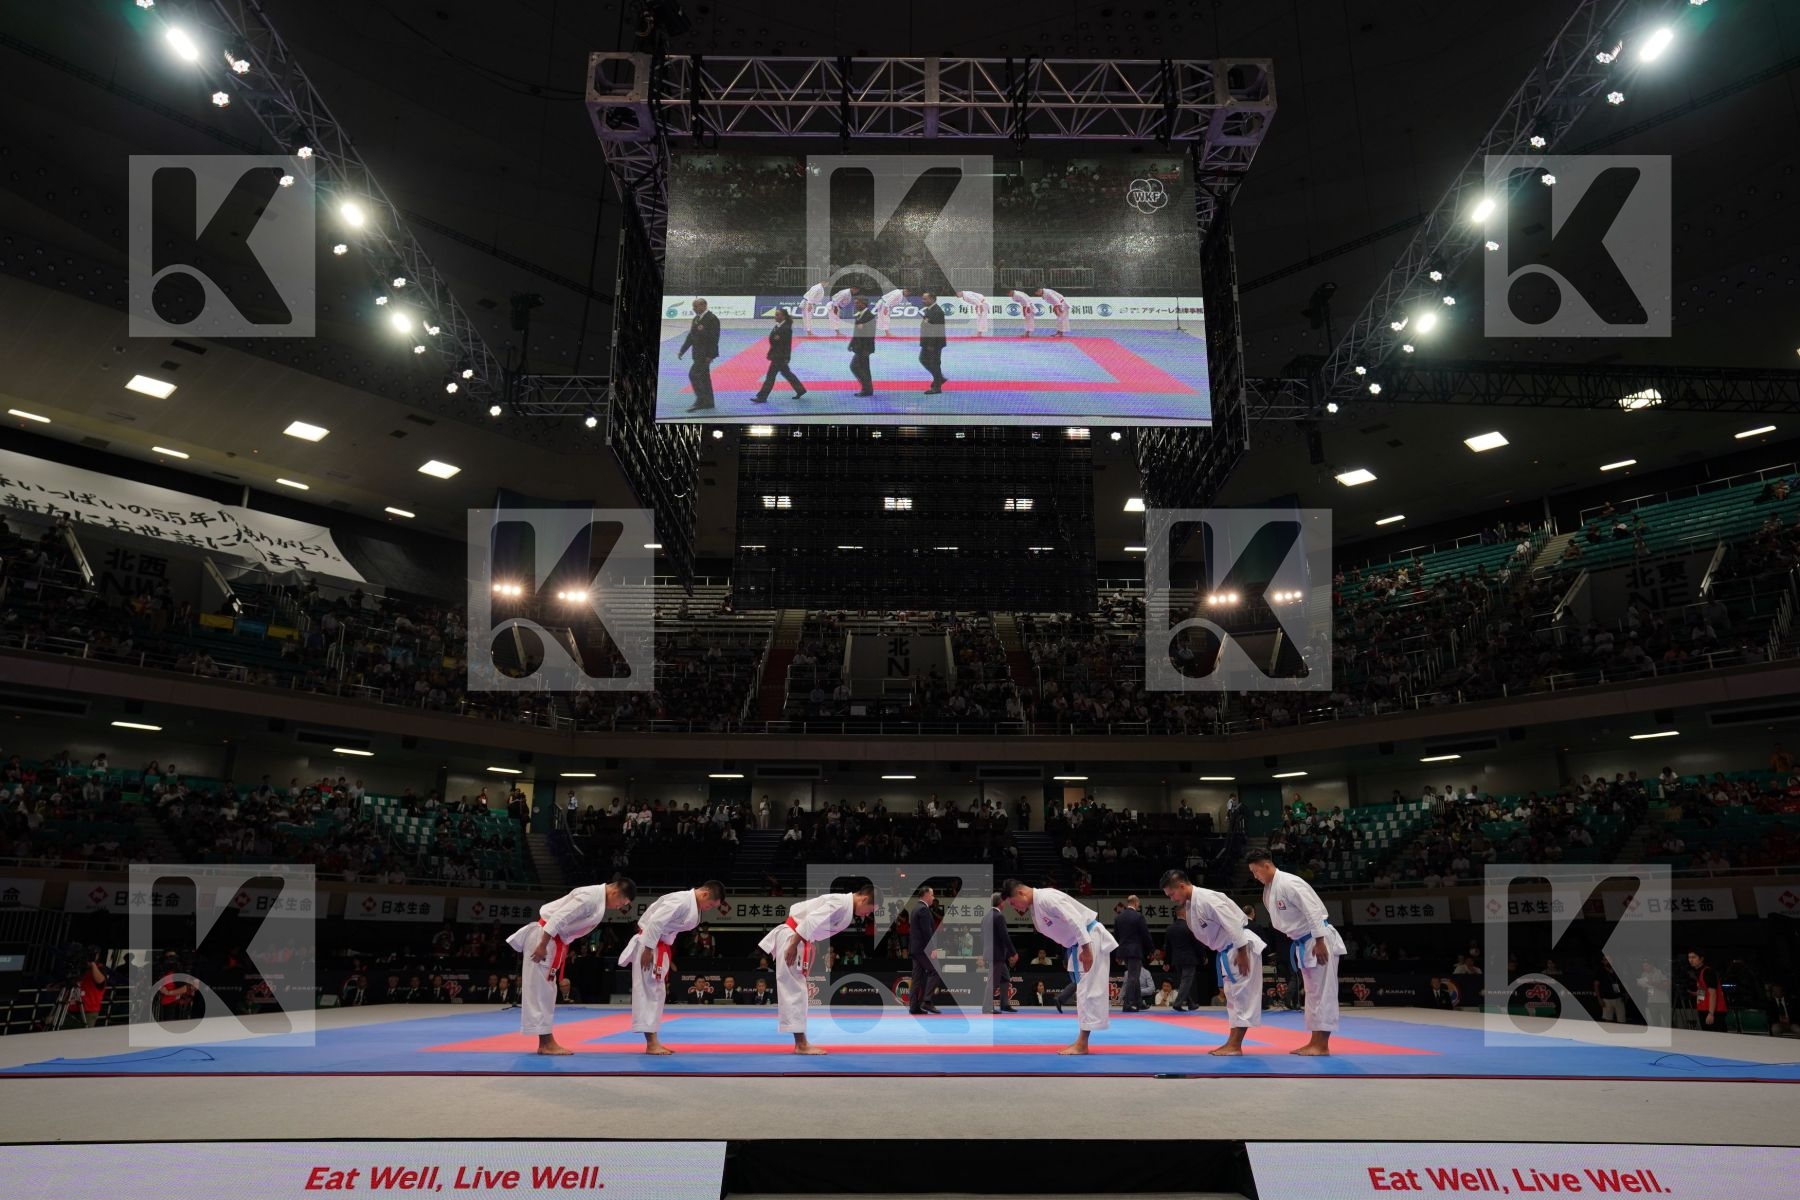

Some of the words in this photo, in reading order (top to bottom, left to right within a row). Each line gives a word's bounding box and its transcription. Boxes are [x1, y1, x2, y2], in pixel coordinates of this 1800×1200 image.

[1132, 191, 1161, 203] WKF
[888, 638, 910, 656] 北
[888, 657, 910, 676] N
[115, 891, 181, 908] 日本生命
[256, 895, 313, 912] 日本生命
[381, 900, 431, 915] 日本生命
[1507, 899, 1564, 915] 日本生命
[1647, 896, 1714, 913] 日本生命
[488, 905, 533, 919] 日本生命
[736, 904, 786, 917] 日本生命
[1385, 904, 1435, 918] 日本生命
[305, 1166, 359, 1190] Eat
[370, 1166, 443, 1192] Well,
[454, 1166, 520, 1190] Live
[531, 1166, 605, 1190] Well.
[1367, 1167, 1422, 1191] Eat
[1425, 1167, 1509, 1194] Well,
[1512, 1168, 1582, 1192] Live
[1584, 1168, 1672, 1194] Well.
